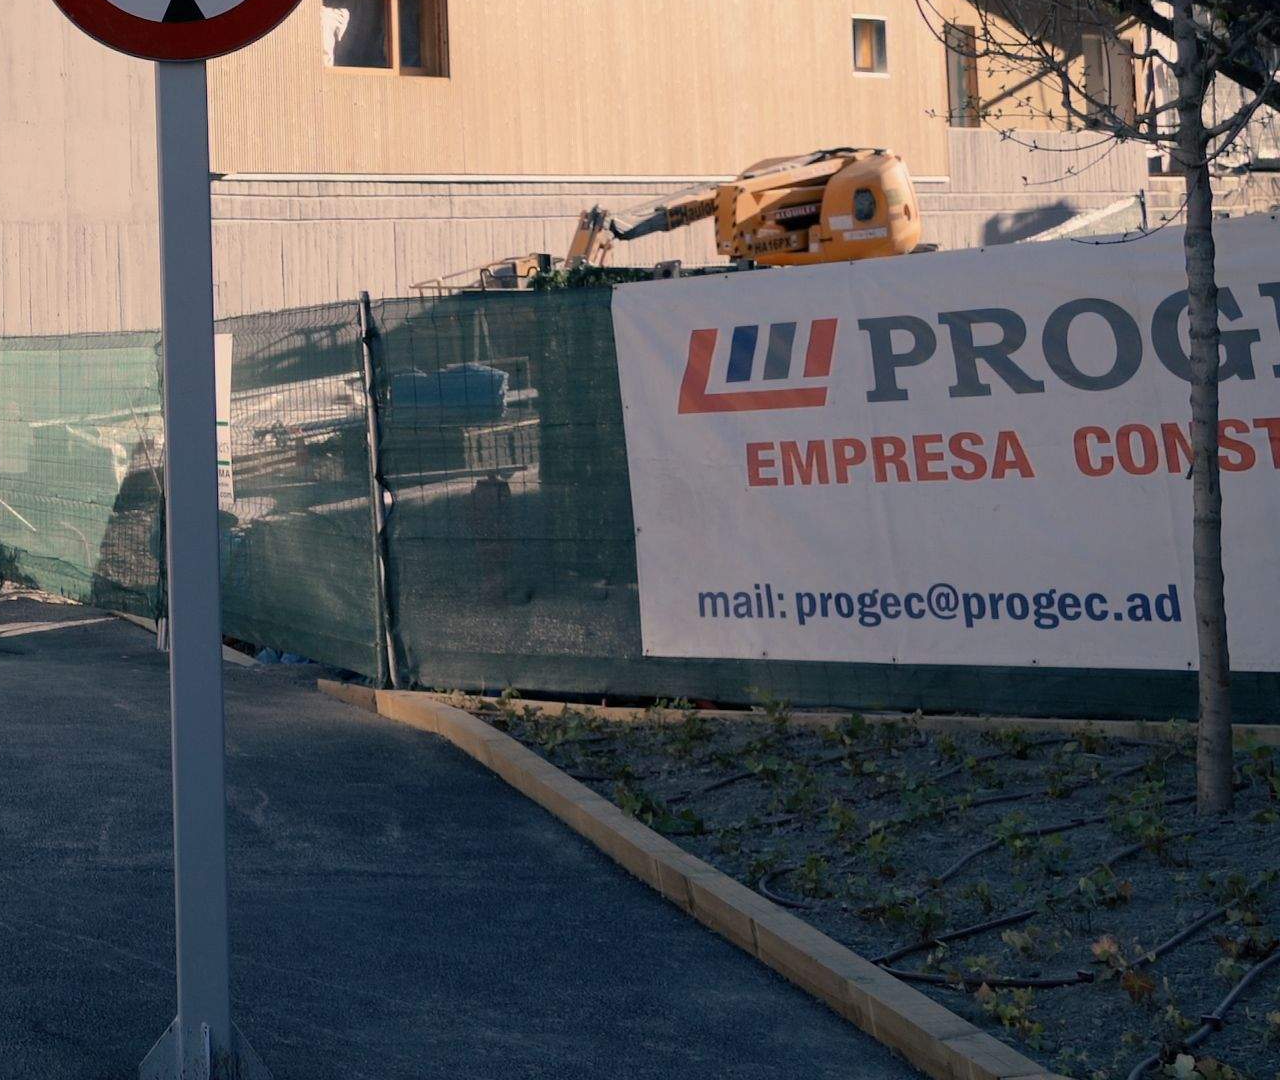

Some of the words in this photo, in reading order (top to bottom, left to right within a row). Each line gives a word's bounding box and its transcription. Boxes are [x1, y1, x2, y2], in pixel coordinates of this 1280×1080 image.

[857, 281, 1280, 403] PROG
[746, 430, 1035, 487] EMPRESA
[698, 583, 787, 620] mail:
[796, 583, 1182, 631] progec@progec.ad
